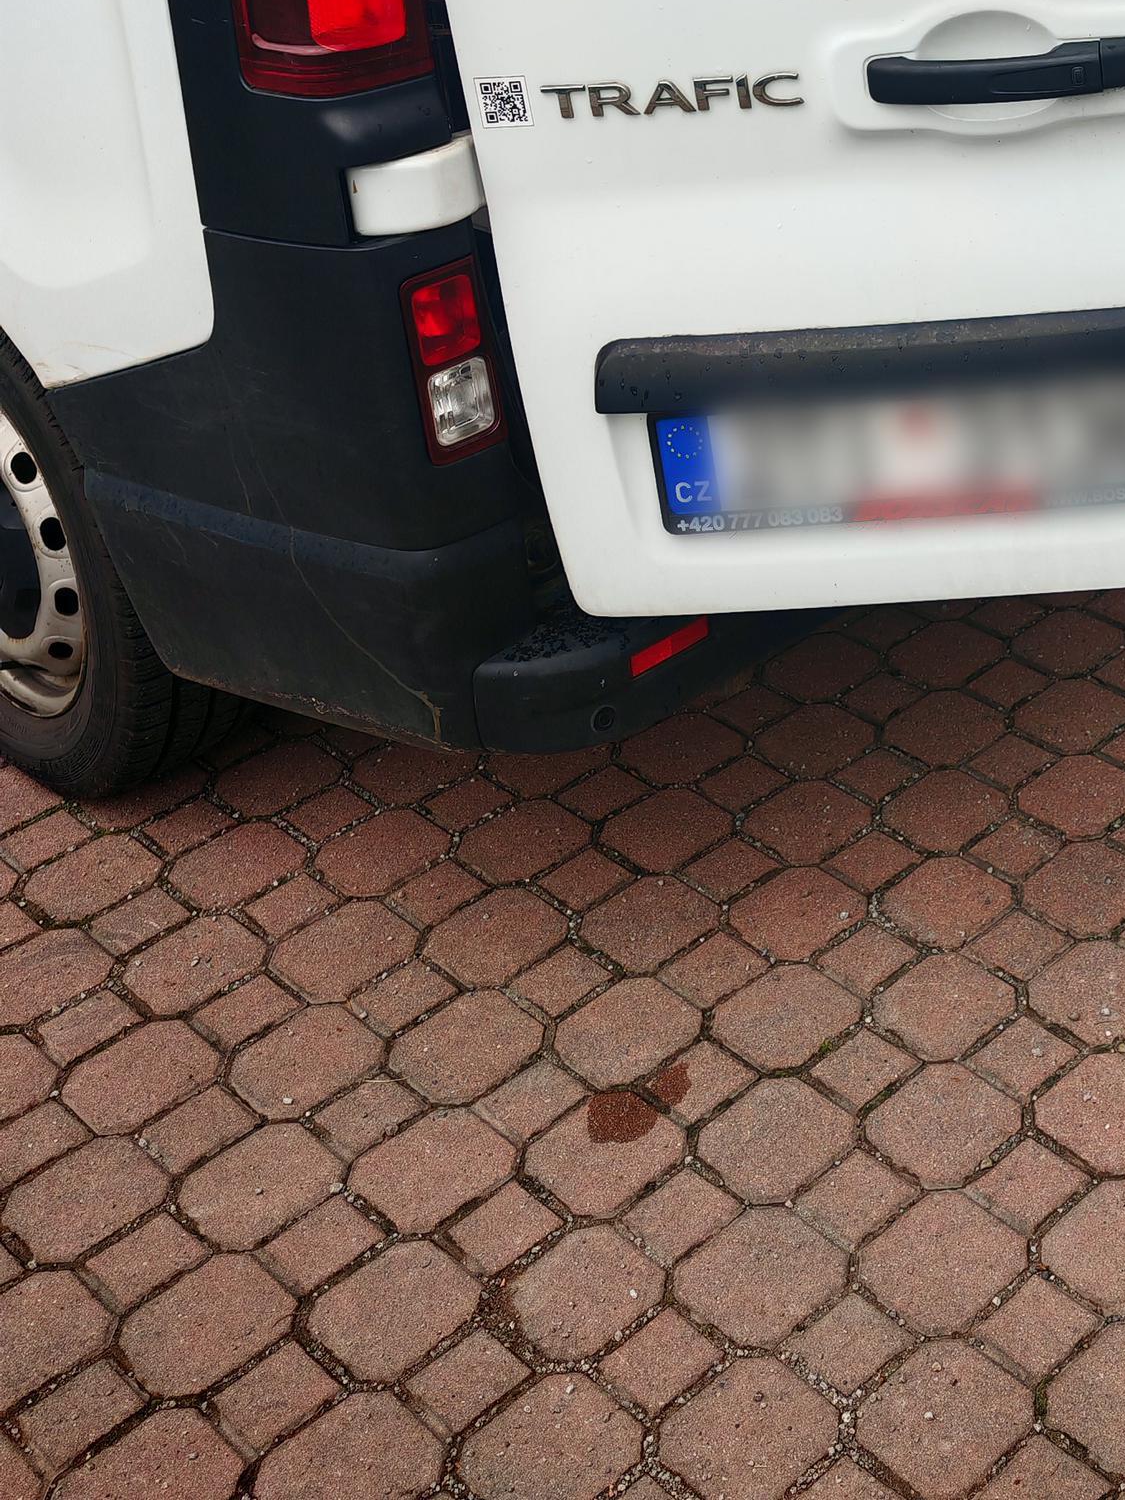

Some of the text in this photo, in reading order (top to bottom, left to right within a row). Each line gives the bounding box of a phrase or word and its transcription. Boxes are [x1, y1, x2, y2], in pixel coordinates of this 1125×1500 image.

[539, 72, 805, 120] TRAFIC
[675, 480, 713, 503] CZ
[677, 515, 725, 533] +420
[727, 512, 763, 530] 777
